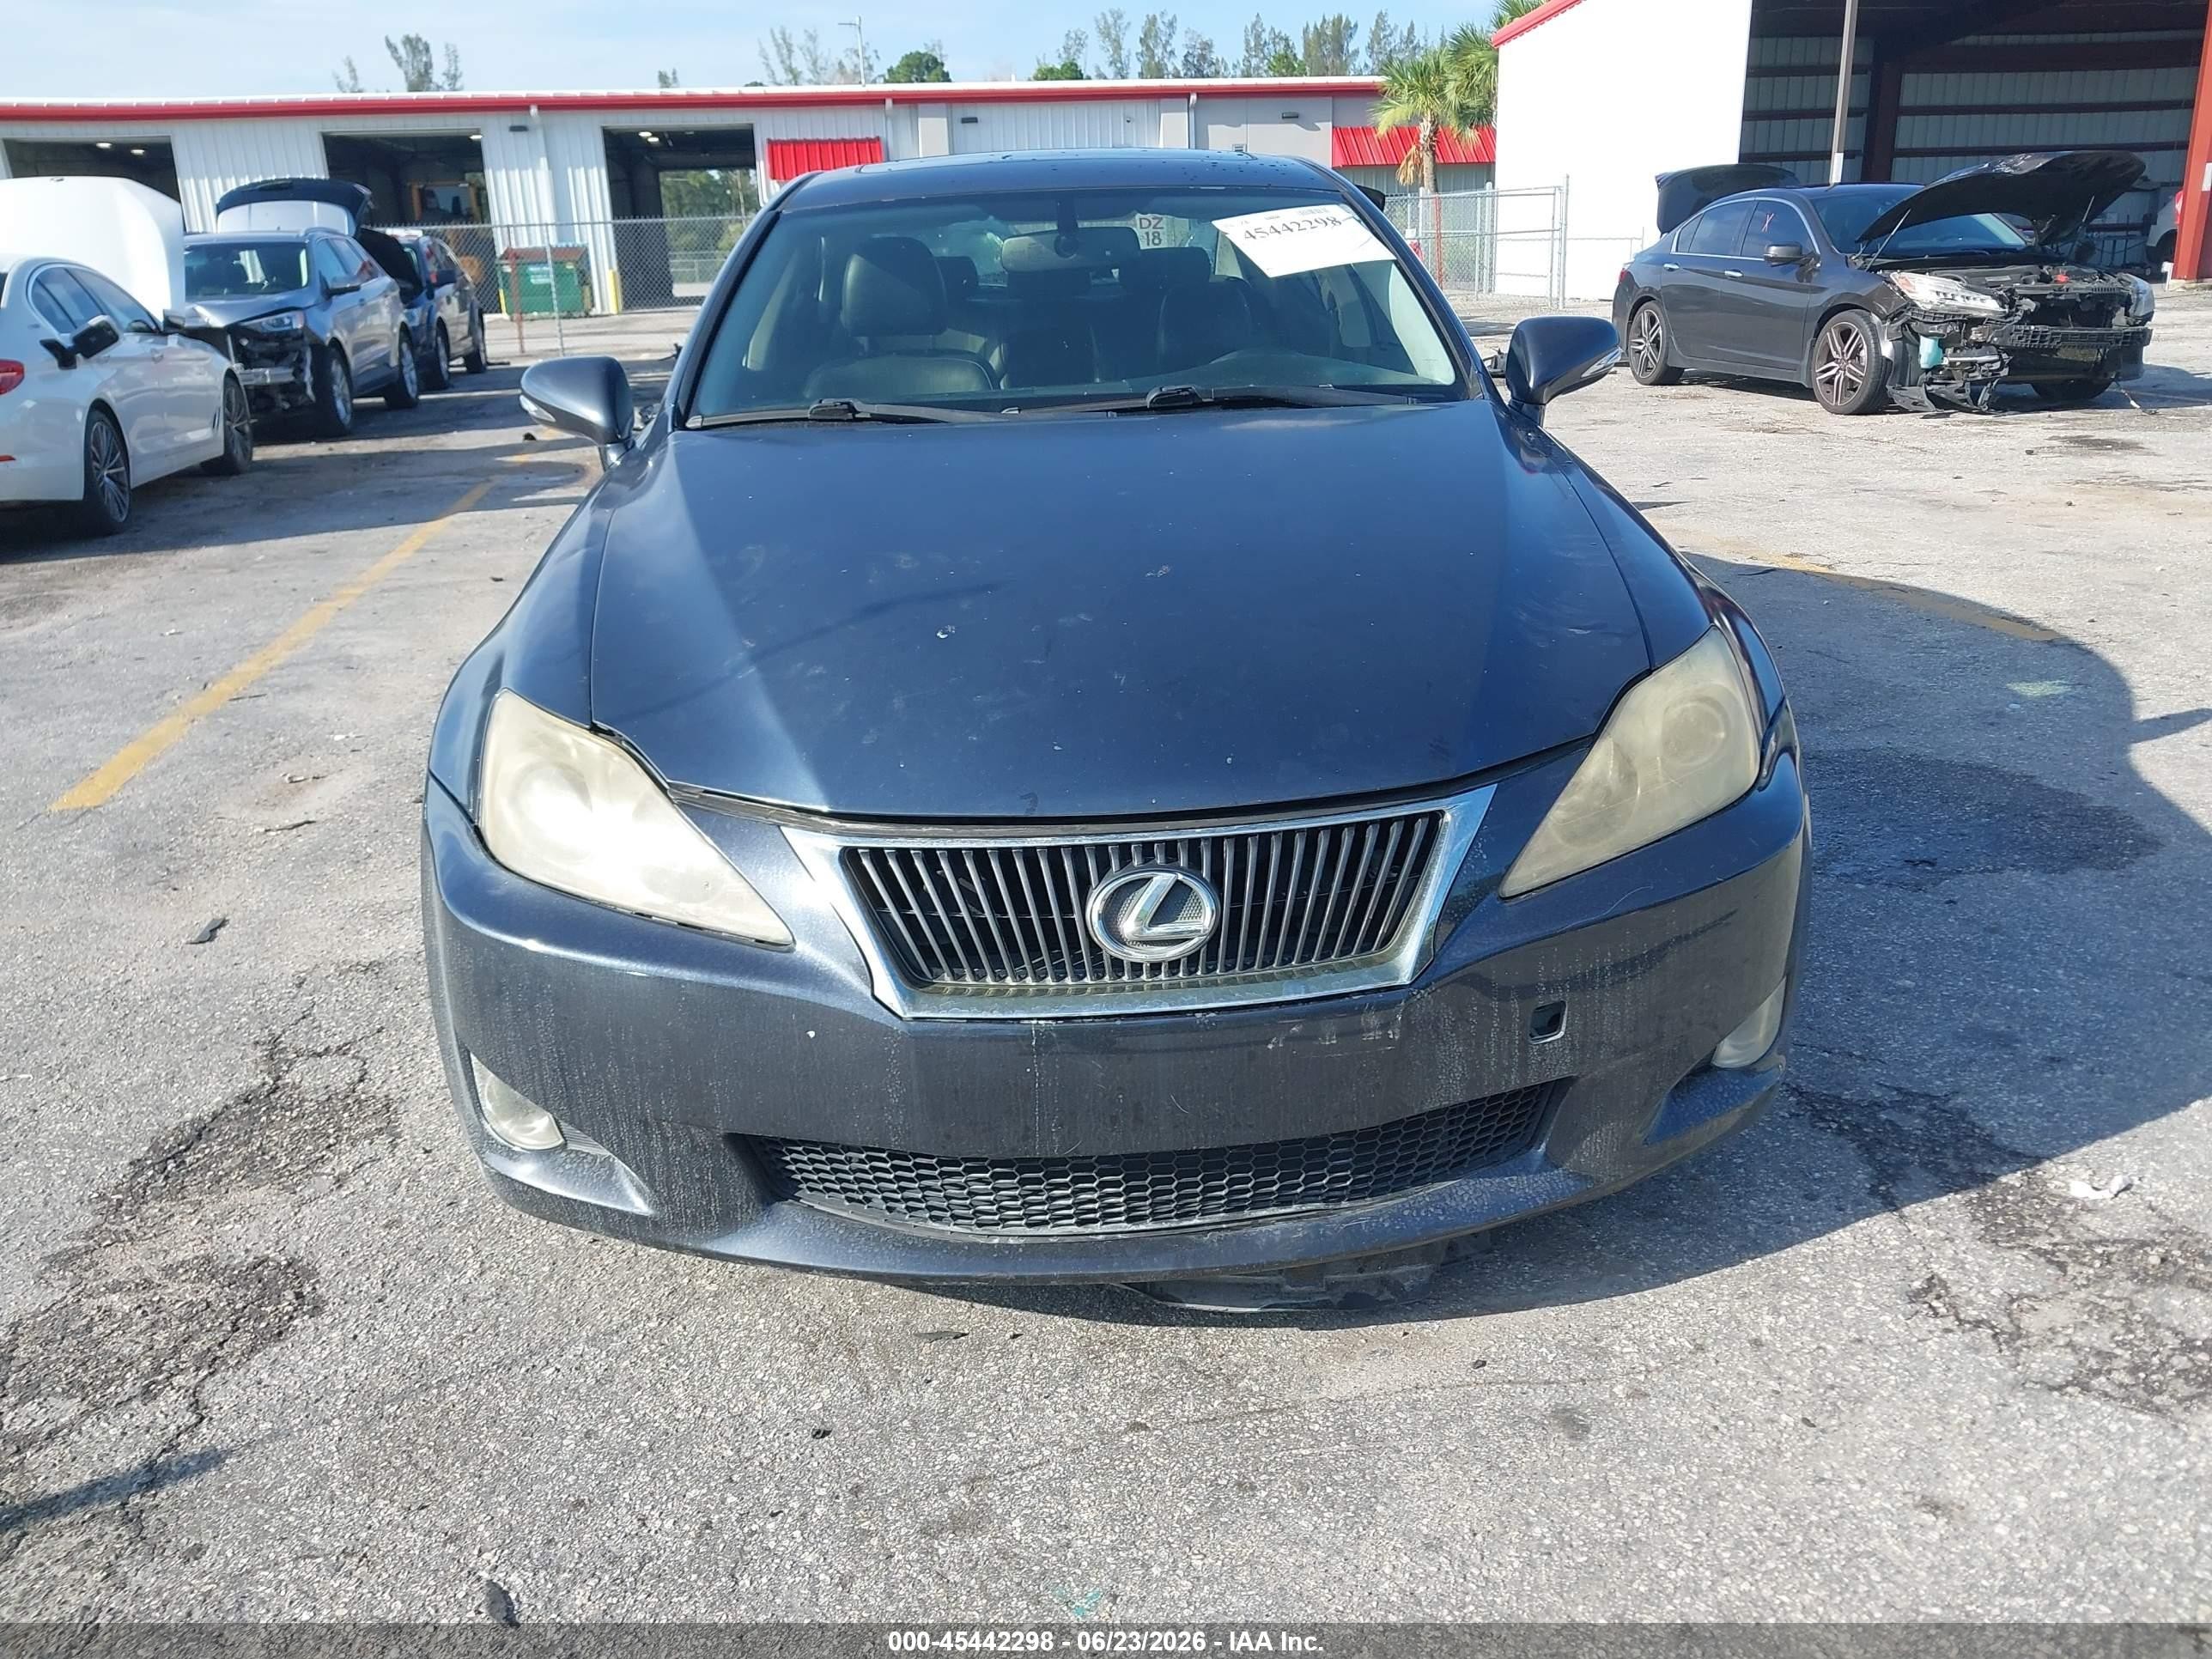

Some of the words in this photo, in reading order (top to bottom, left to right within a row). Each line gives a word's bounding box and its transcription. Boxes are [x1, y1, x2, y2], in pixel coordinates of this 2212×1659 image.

[1139, 217, 1164, 229] DZ
[1243, 216, 1341, 240] 45442298
[1145, 231, 1163, 246] 18
